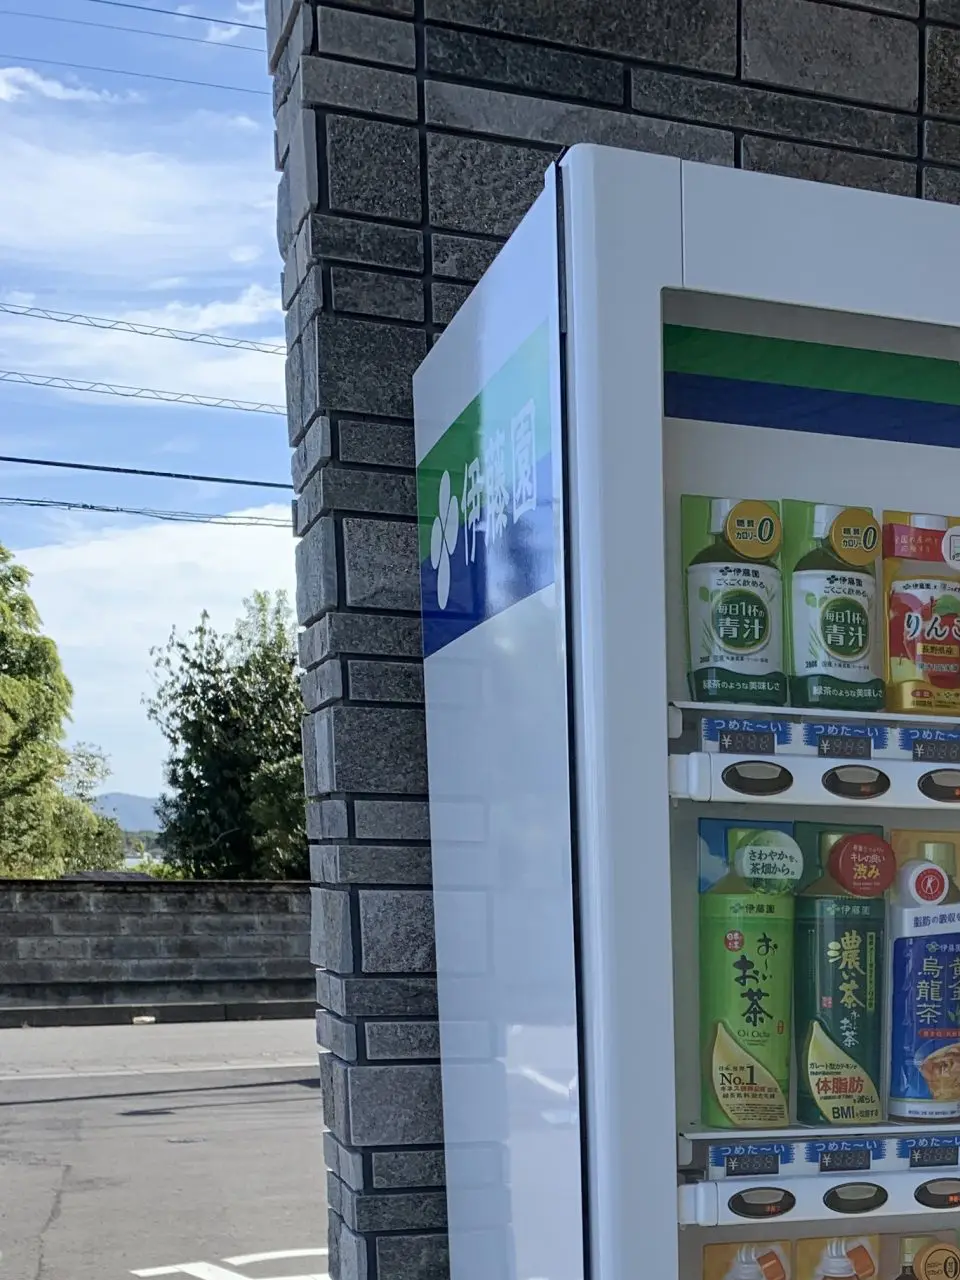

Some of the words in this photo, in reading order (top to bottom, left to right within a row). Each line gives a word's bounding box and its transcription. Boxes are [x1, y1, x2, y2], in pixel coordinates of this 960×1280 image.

[461, 397, 536, 566] 伊藤園
[718, 618, 764, 640] 青汁
[825, 623, 867, 647] 青汁
[853, 864, 881, 880] 渋み
[732, 954, 774, 1028] お茶
[916, 956, 944, 1025] 烏龍茶
[720, 1065, 758, 1087] No.1
[815, 1075, 865, 1095] 体脂肪
